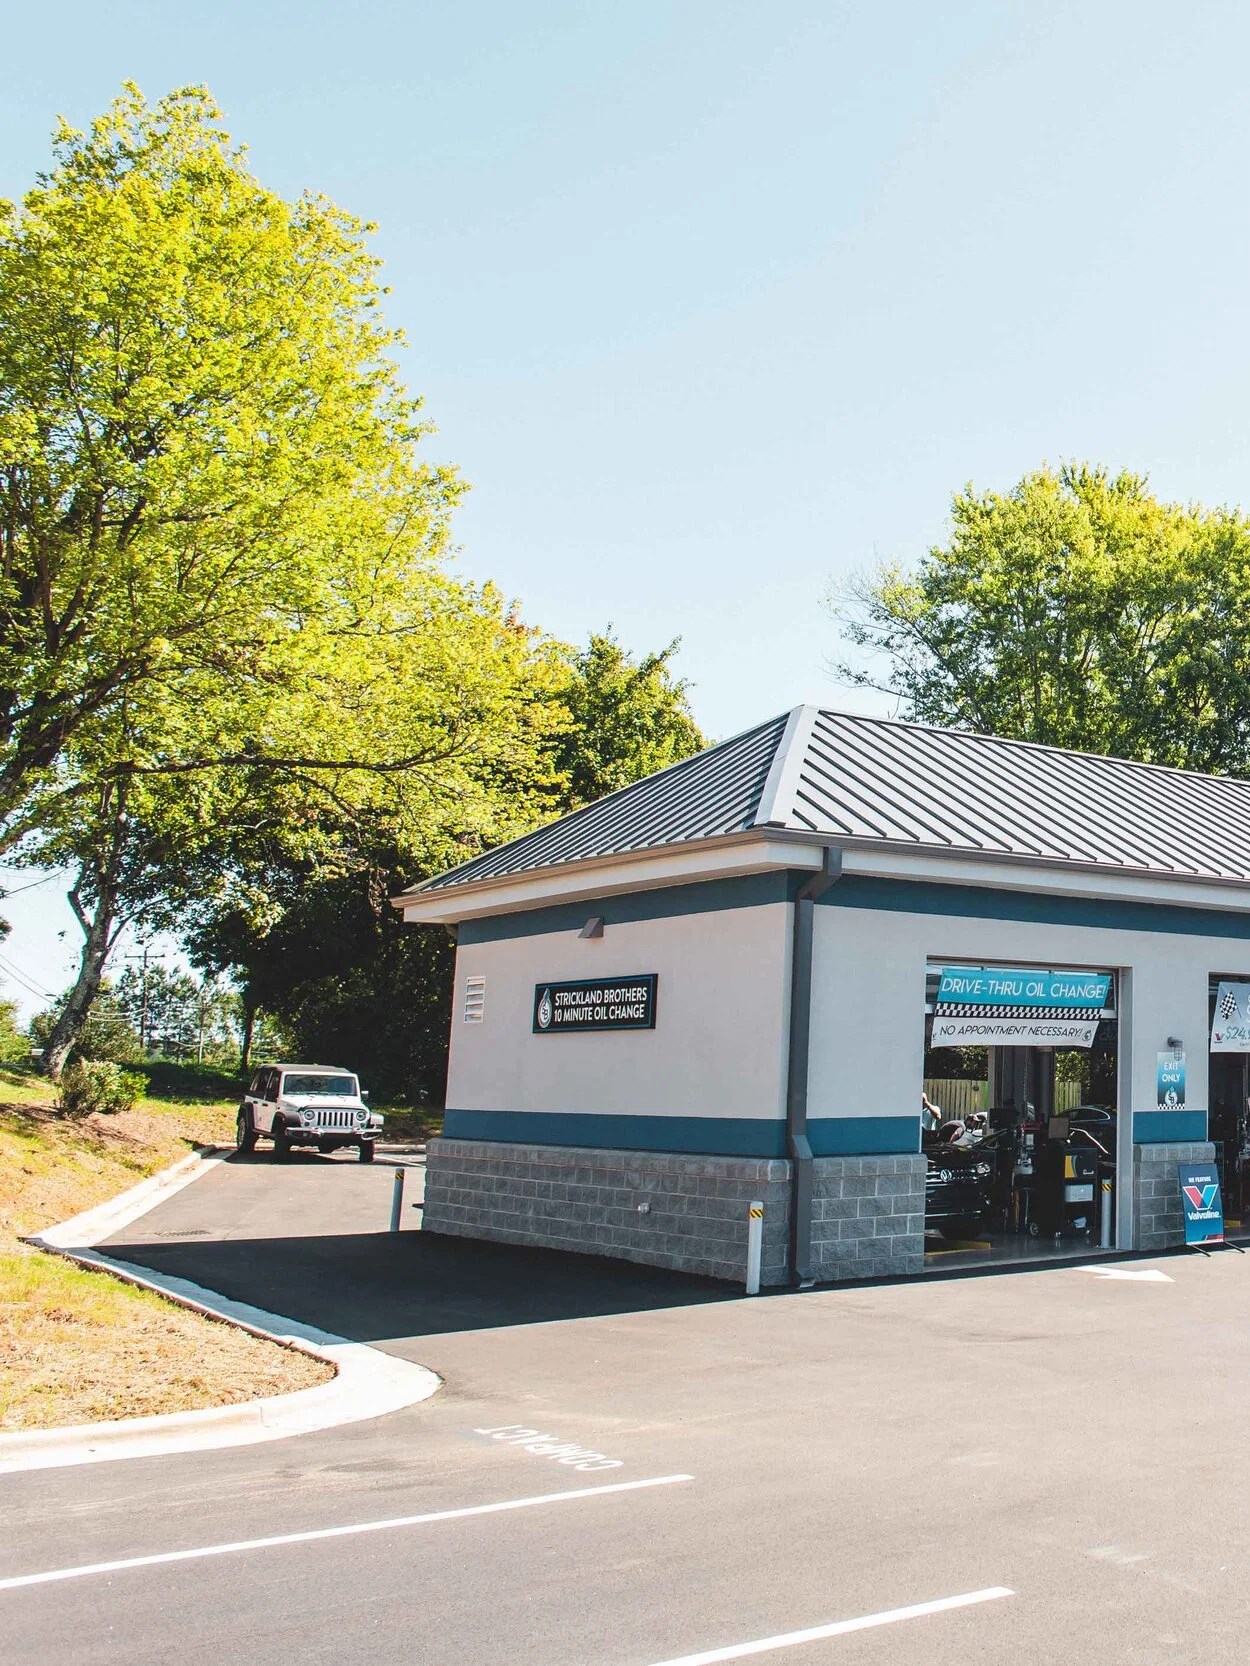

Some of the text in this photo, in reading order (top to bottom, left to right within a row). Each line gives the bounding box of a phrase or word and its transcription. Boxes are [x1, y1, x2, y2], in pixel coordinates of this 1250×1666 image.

[941, 977, 1107, 999] DRIVE-THRU OIL CHANGE!
[555, 987, 648, 1006] STRICKLAND BROTHERS
[554, 1004, 645, 1022] 10 MINUTE OIL CHANGE
[939, 1025, 956, 1036] NO
[957, 1025, 1029, 1036] APPOINTMENT
[1027, 1026, 1083, 1038] NECESSARY!
[1164, 1062, 1178, 1071] EXIT
[1161, 1073, 1181, 1082] ONLY
[1187, 1211, 1220, 1221] Valvoline
[472, 1424, 624, 1472] COMPACT
